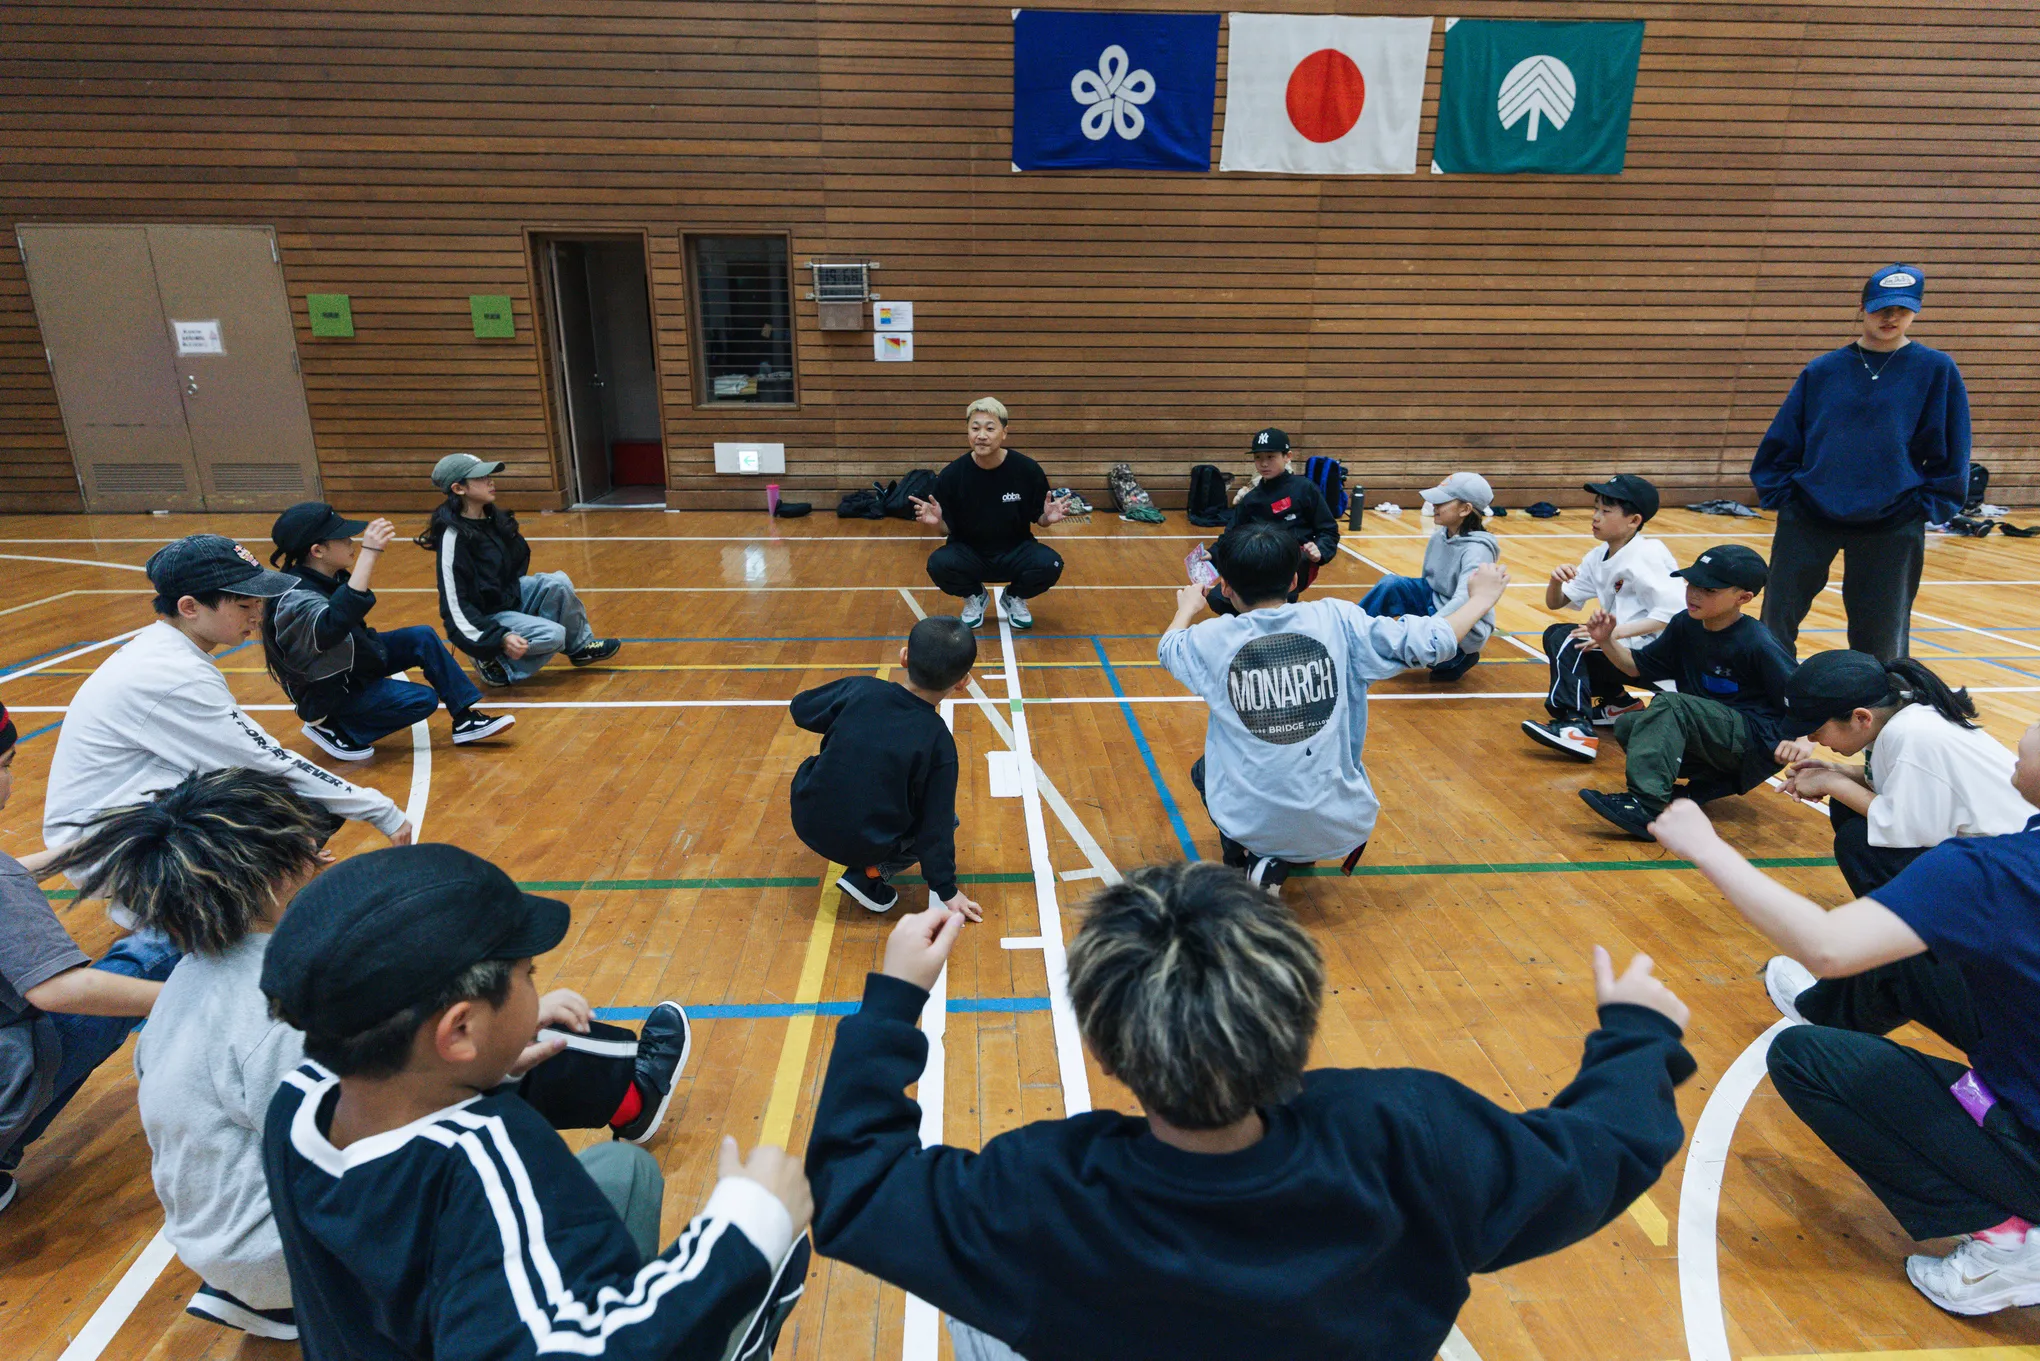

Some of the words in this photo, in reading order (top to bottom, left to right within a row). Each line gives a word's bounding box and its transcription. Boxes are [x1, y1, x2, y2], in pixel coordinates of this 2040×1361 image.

[1230, 657, 1335, 712] MONARCH
[1269, 722, 1304, 734] BRIDGE
[291, 759, 343, 788] NEVER
